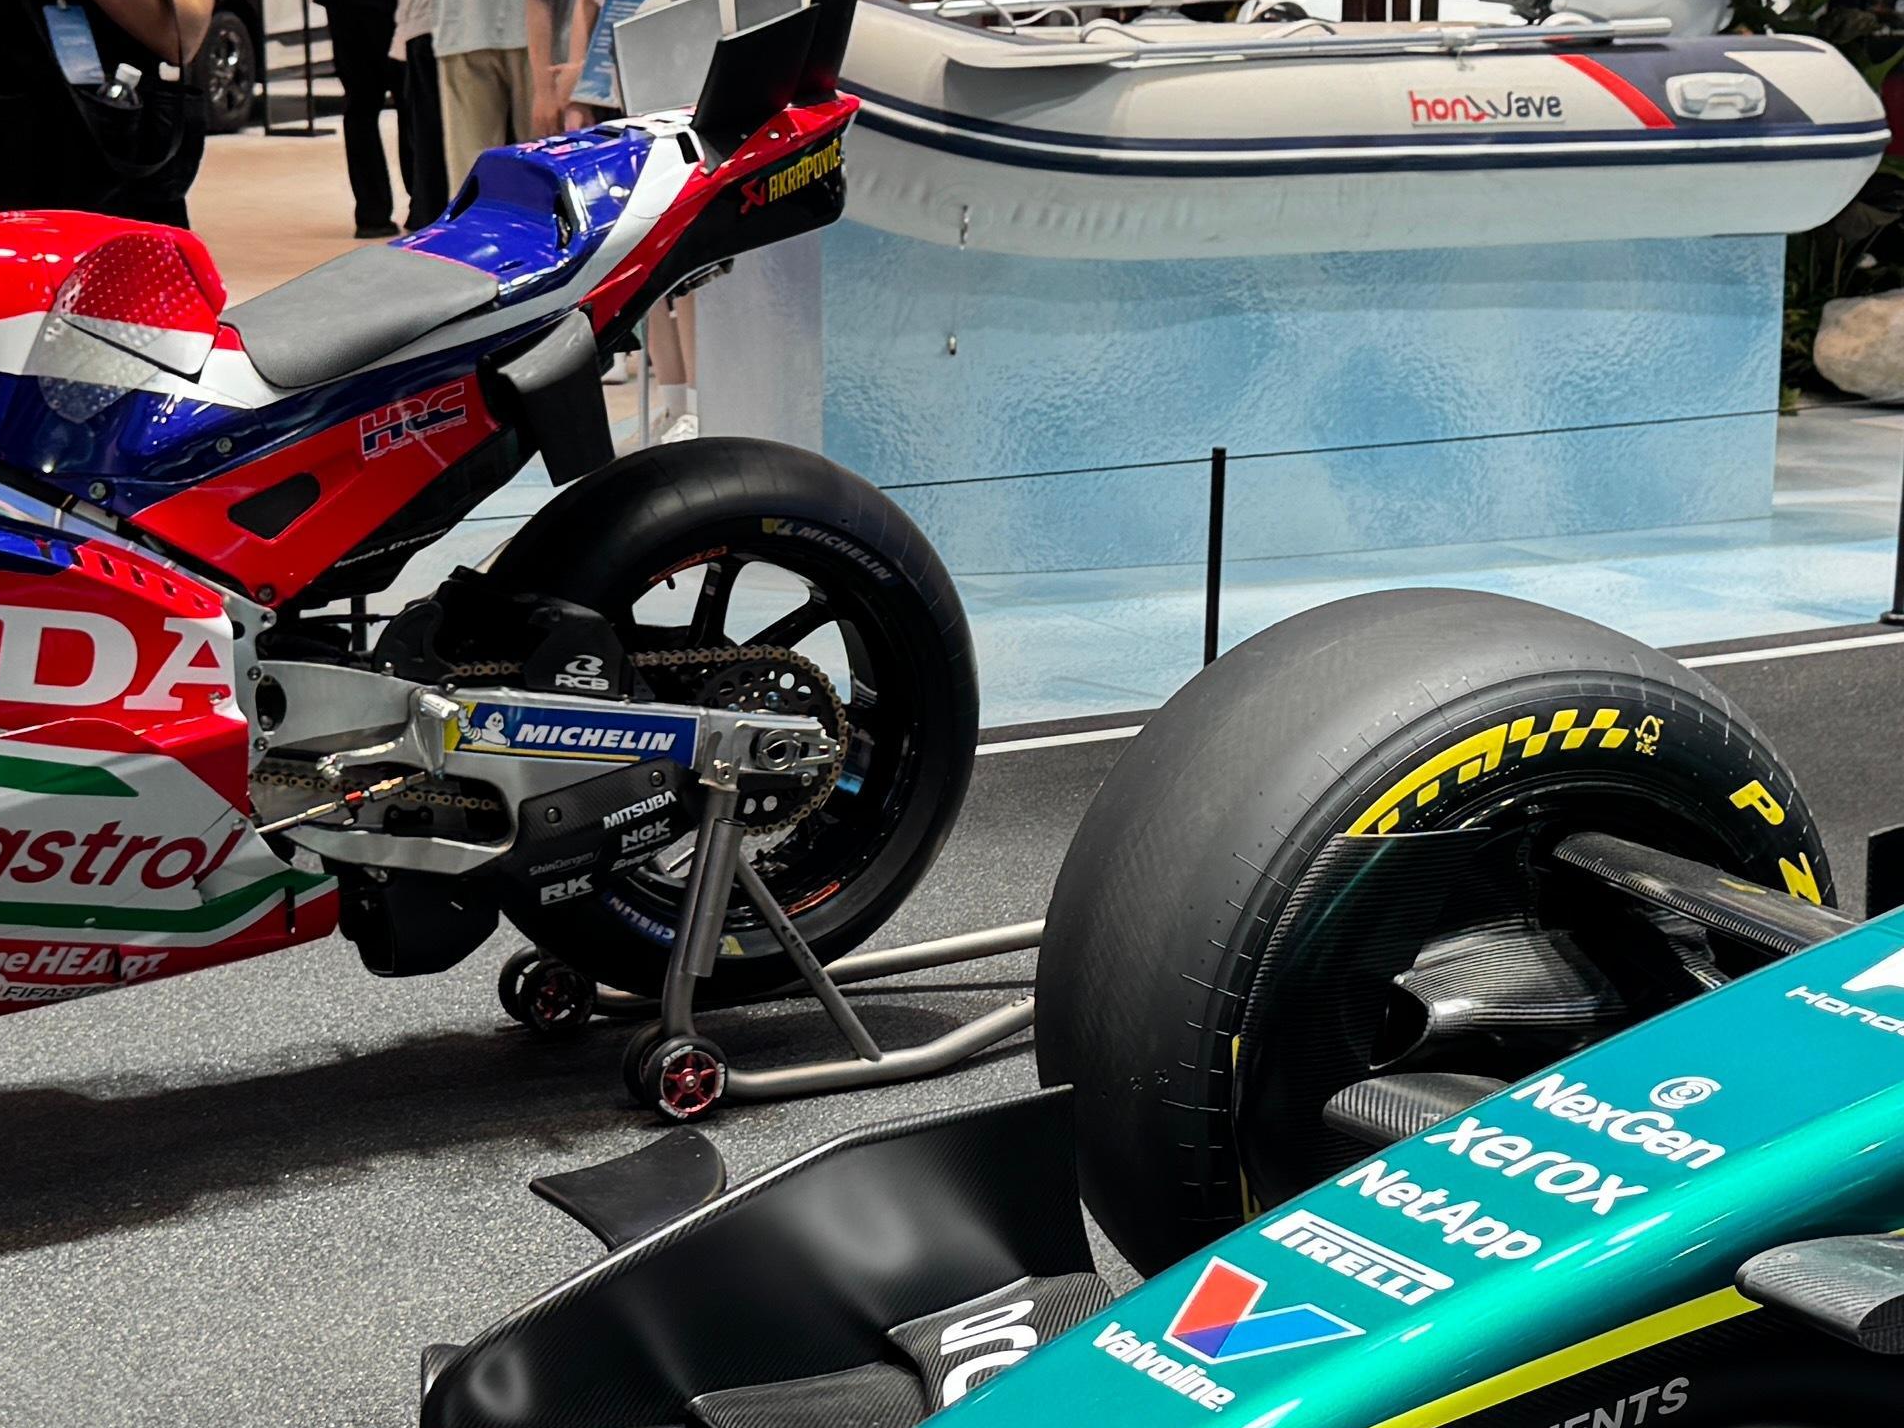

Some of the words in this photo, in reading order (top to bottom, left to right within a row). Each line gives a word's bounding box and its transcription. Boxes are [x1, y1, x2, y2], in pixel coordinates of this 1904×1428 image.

[358, 381, 467, 457] HRC
[794, 525, 894, 582] MICHELIN
[553, 671, 610, 692] RCB
[514, 722, 676, 752] MICHELIN
[602, 789, 678, 831] MITSUBA
[1728, 778, 1785, 826] P
[620, 817, 671, 848] NGK
[541, 873, 594, 904] RK
[608, 896, 677, 940] CHELIN
[1509, 1070, 1728, 1173] NexGen
[1337, 1157, 1544, 1265] NetApp
[1260, 1208, 1457, 1307] PIRELLI
